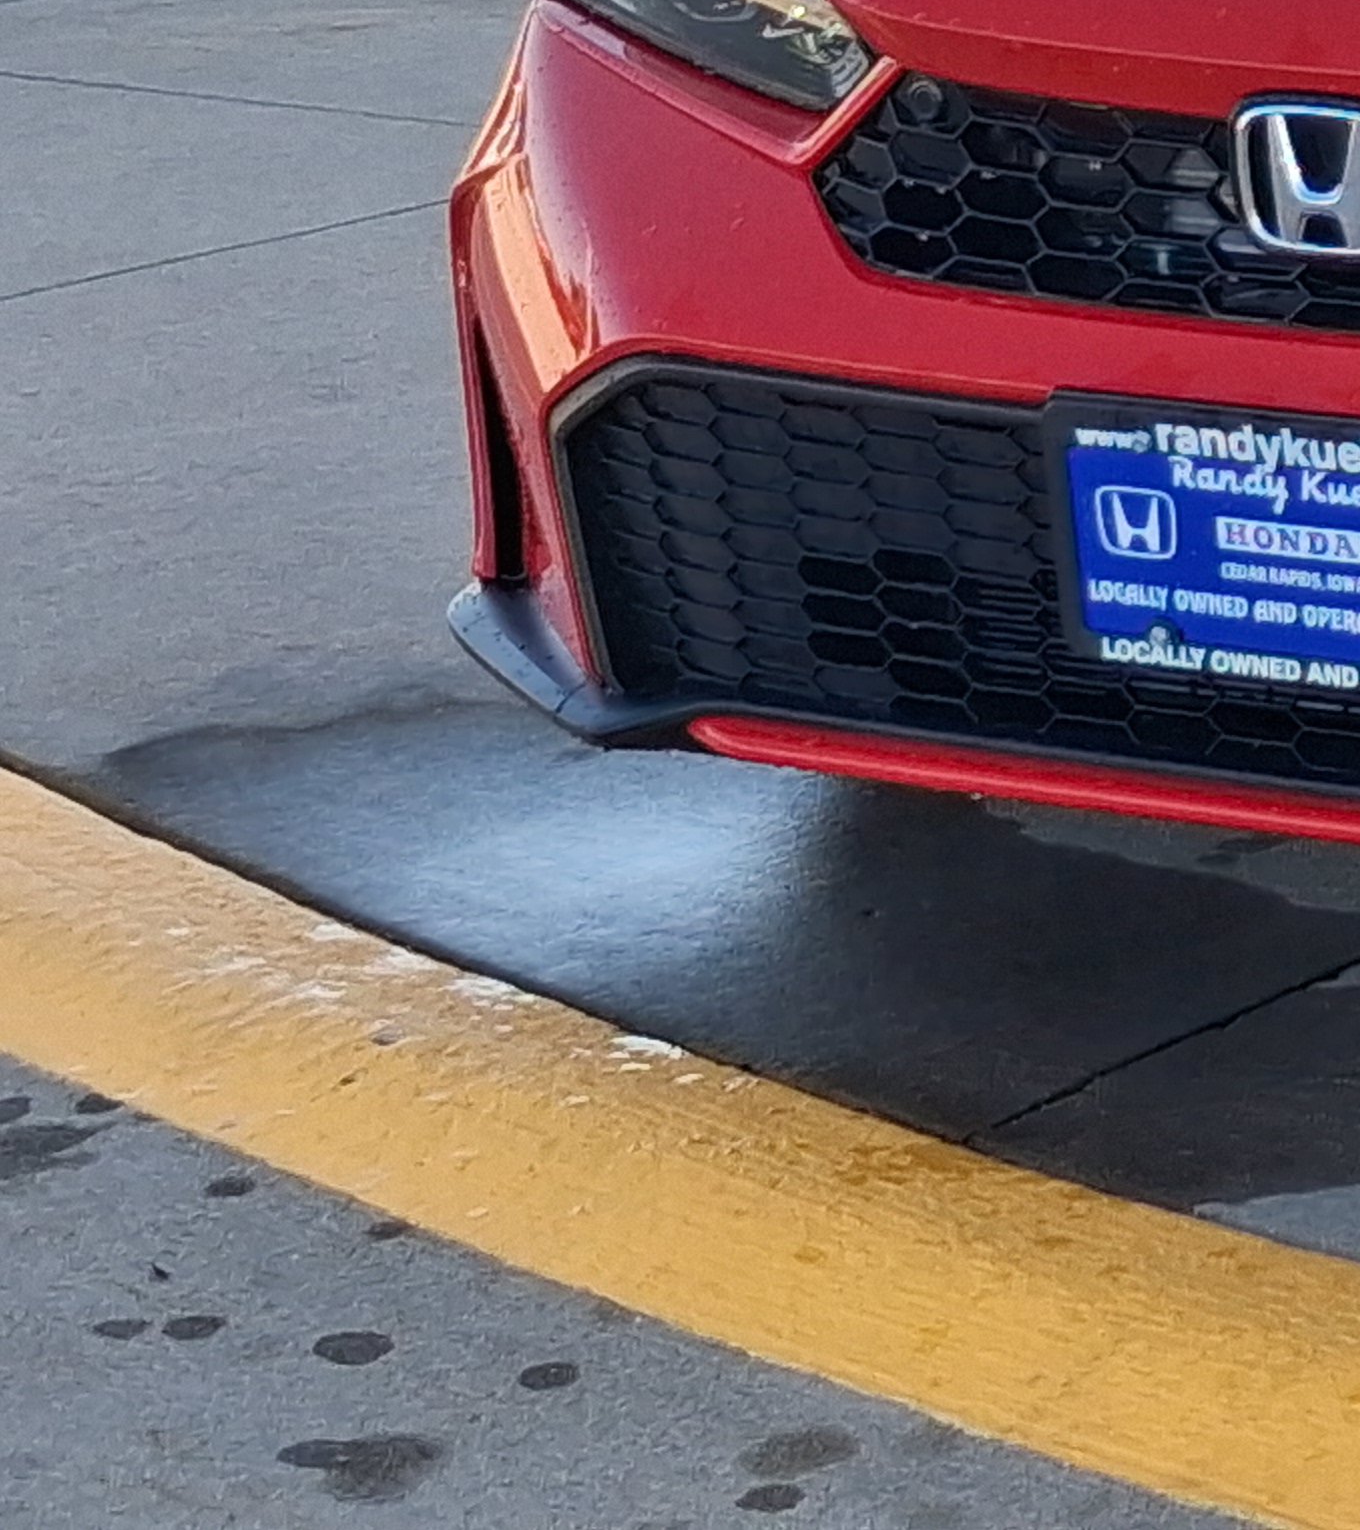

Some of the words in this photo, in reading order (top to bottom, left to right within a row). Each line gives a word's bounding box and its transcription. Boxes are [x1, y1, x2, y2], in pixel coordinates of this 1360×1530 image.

[1168, 457, 1289, 515] Randy
[1224, 521, 1358, 559] HONDA
[1089, 579, 1168, 612] LOCALLY
[1173, 590, 1248, 619] OWNED
[1253, 600, 1297, 624] AND
[1101, 636, 1206, 671] LOCALLY
[1210, 650, 1301, 681] OWNED
[1306, 661, 1359, 688] AND
